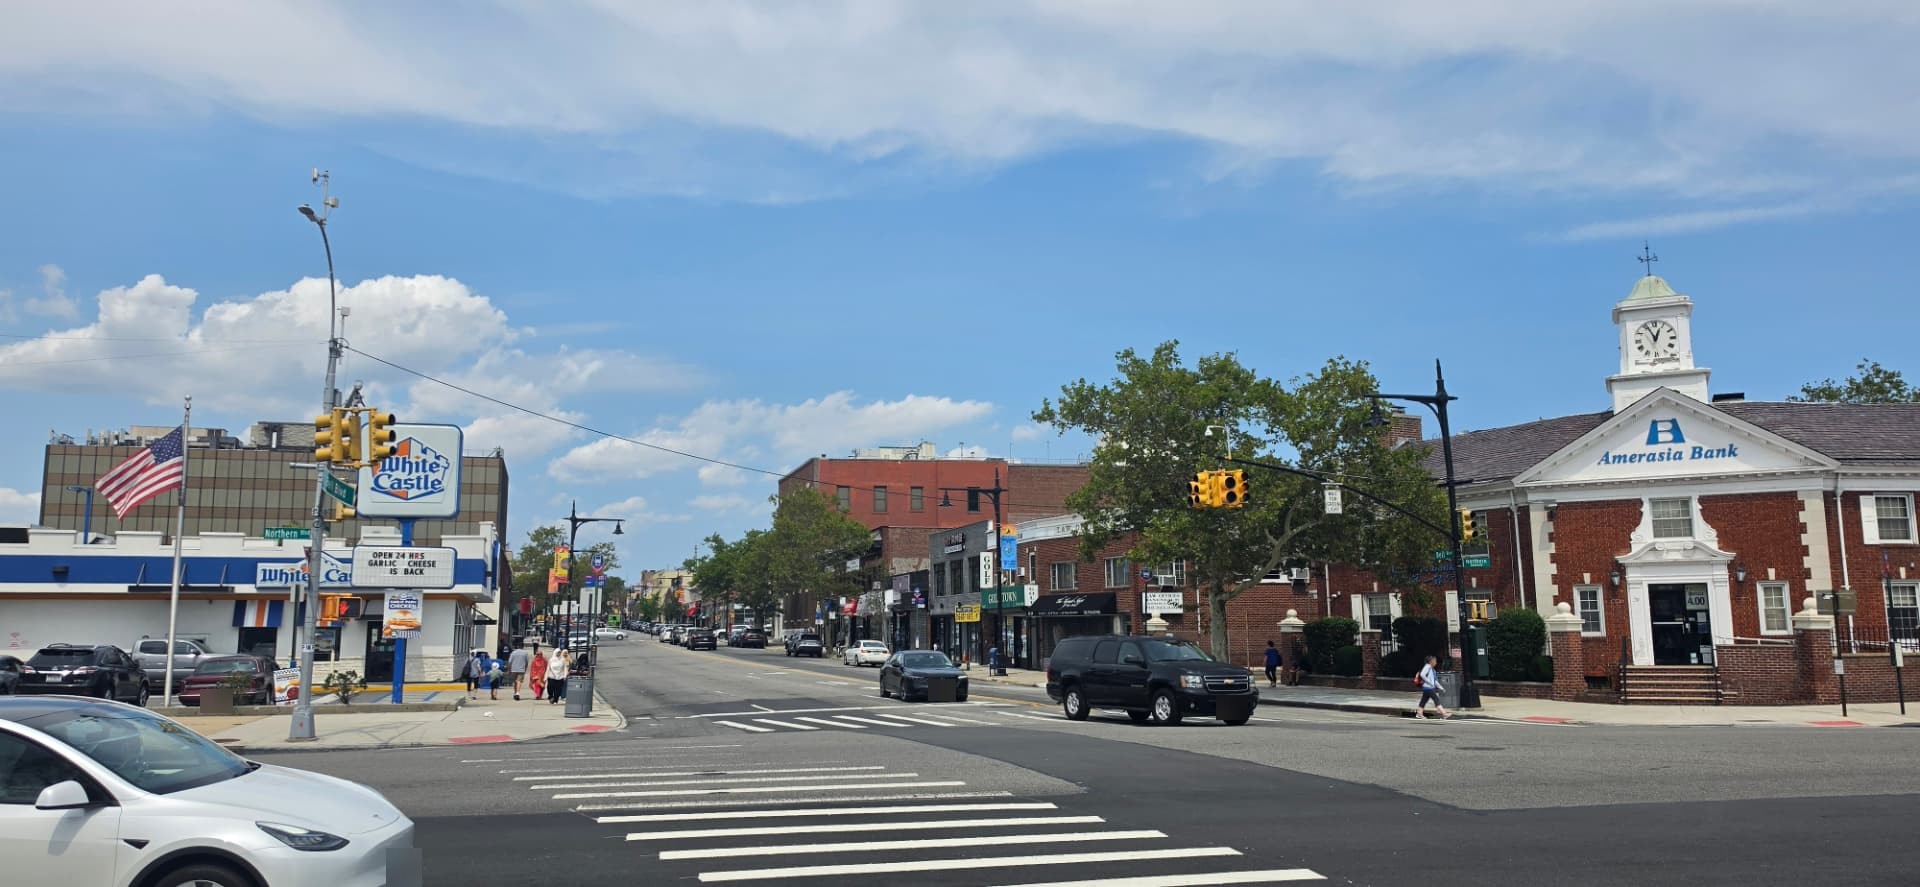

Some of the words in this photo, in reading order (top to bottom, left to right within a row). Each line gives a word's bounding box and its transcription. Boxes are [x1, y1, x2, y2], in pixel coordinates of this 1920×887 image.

[1597, 447, 1683, 465] Amerasia
[1690, 443, 1739, 460] Bank
[379, 455, 441, 476] White
[373, 473, 443, 490] Castle
[265, 529, 298, 538] Northern
[261, 568, 309, 584] White
[983, 555, 991, 585] GOLF
